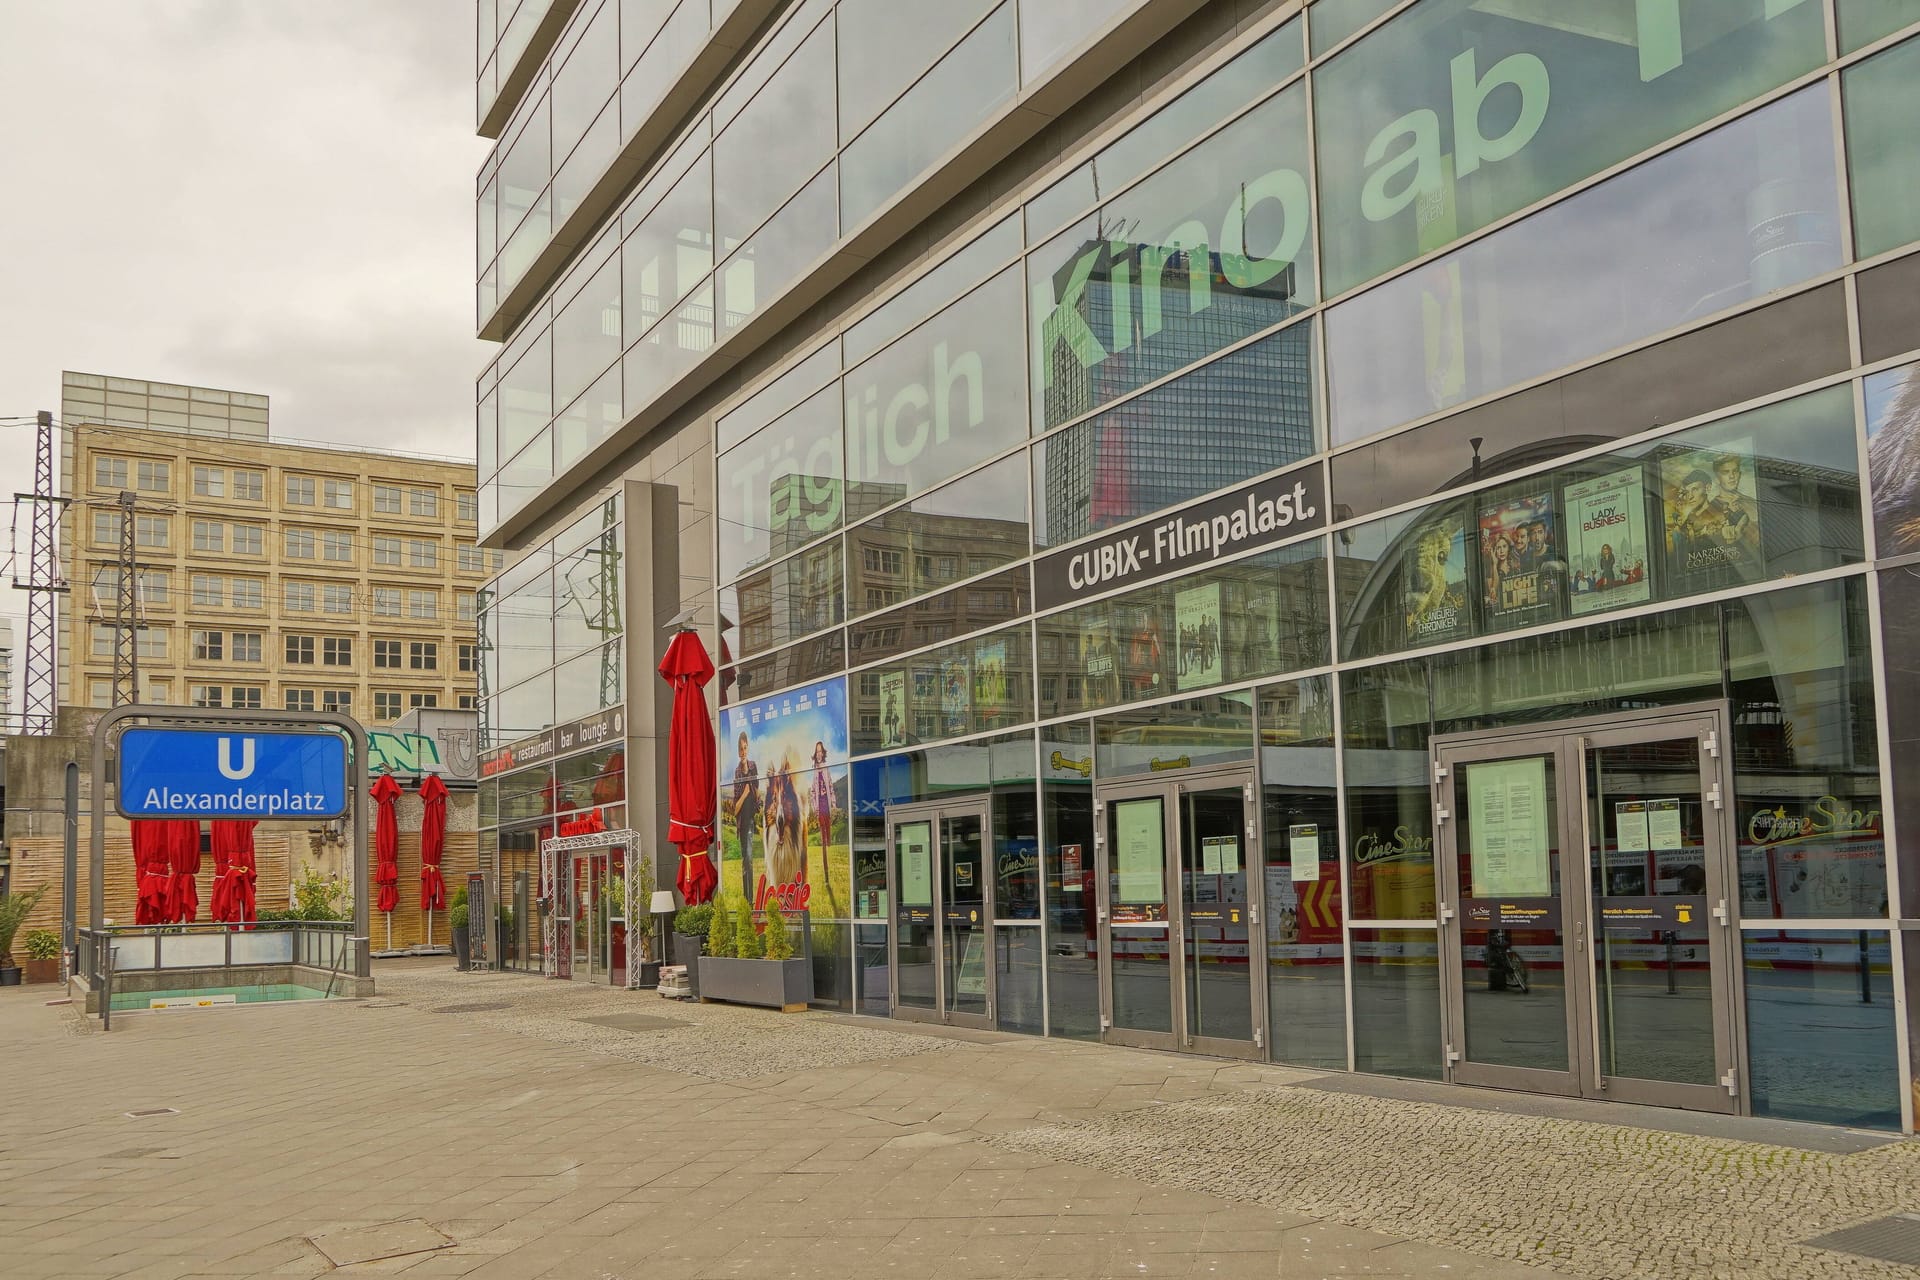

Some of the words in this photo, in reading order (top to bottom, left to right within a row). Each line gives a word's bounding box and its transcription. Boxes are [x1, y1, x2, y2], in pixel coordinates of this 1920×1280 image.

[731, 340, 984, 544] Täglich
[1032, 168, 1310, 393] Kino
[1361, 47, 1550, 222] ab
[1583, 513, 1626, 532] BUSINESS
[1592, 506, 1616, 521] LADY
[1502, 574, 1539, 592] NIGHT
[1503, 587, 1538, 609] LIFE
[518, 737, 552, 761] restaurant
[561, 730, 573, 748] bar
[580, 721, 607, 743] lounge
[218, 738, 255, 780] U
[143, 787, 325, 816] Alexanderplatz
[1748, 795, 1881, 845] CineStar
[1355, 826, 1432, 862] CineStar
